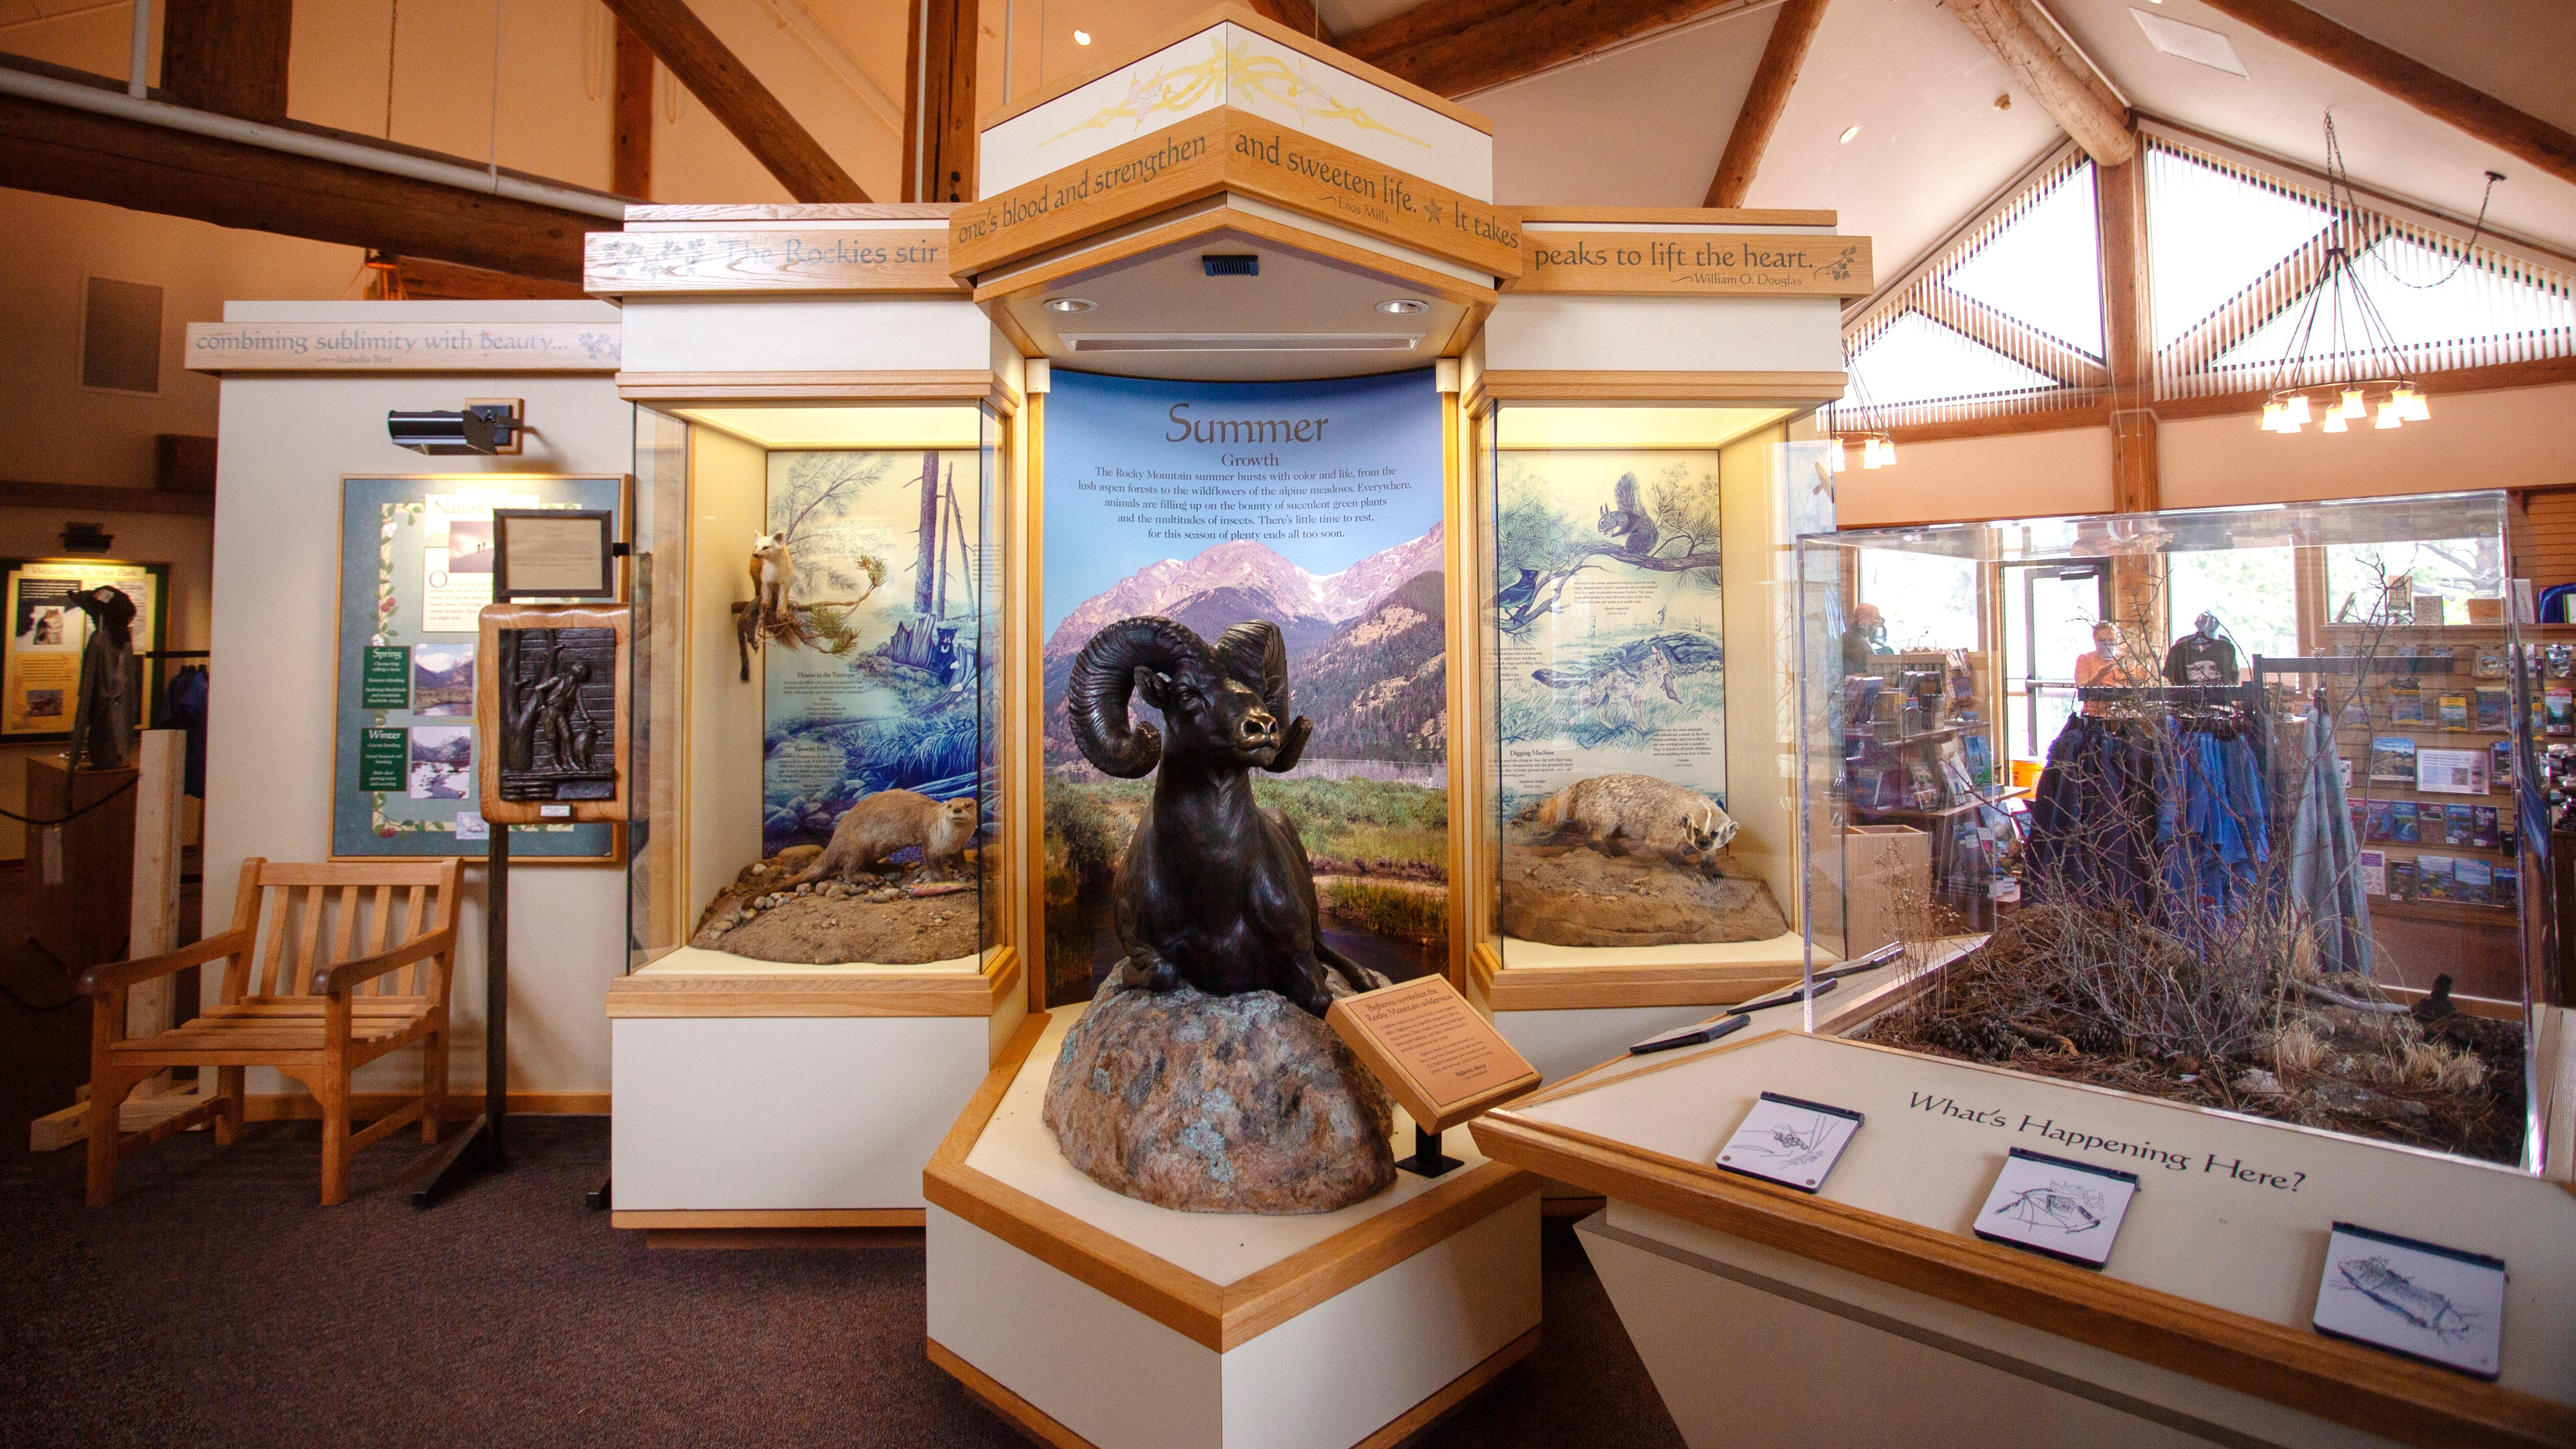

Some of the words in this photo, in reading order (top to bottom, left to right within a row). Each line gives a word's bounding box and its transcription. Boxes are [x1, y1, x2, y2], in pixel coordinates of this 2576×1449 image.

[1235, 133, 1281, 168] and
[1286, 148, 1376, 198] sweeten
[1383, 173, 1417, 214] life.
[957, 208, 998, 244] one's
[1002, 185, 1050, 231] blood
[1053, 169, 1090, 208] and
[1094, 131, 1206, 194] strengthen
[1336, 195, 1362, 213] Enos
[1363, 202, 1390, 224] Mills
[1454, 201, 1470, 231] It
[1474, 212, 1519, 249] takes
[719, 240, 775, 265] The
[784, 238, 887, 265] Rockies
[895, 238, 939, 264] stir
[1534, 241, 1607, 270] peaks
[1618, 245, 1641, 266] to
[1651, 241, 1686, 272] lift
[1696, 243, 1736, 268] the
[1742, 243, 1814, 269] heart.
[1694, 273, 1736, 285] William
[1740, 274, 1754, 285] O.
[1757, 274, 1802, 288] Douglas
[196, 330, 308, 354] combining
[316, 330, 417, 354] sublimity
[424, 330, 472, 350] with
[481, 330, 569, 354] beauty...
[1166, 403, 1328, 443] Summer
[1221, 453, 1279, 467] Growth
[1095, 467, 1113, 477] The
[1117, 468, 1144, 480] Rocky
[1147, 470, 1192, 480] Mountain
[1238, 471, 1266, 481] bursts
[1270, 471, 1290, 480] with
[1294, 470, 1317, 480] color
[1320, 470, 1335, 479] and
[1339, 469, 1355, 479] life,
[1358, 468, 1379, 477] from
[1383, 466, 1396, 475] the
[1078, 481, 1096, 490] lush
[1099, 485, 1125, 493] aspen
[1128, 484, 1157, 493] forests
[1174, 485, 1188, 494] the
[1192, 486, 1246, 495] wildflowers
[1249, 486, 1258, 495] of
[1261, 486, 1276, 495] the
[1279, 485, 1307, 496] alpine
[1310, 484, 1354, 494] meadows.
[433, 500, 487, 515] Natural
[1105, 498, 1140, 508] animals
[1160, 499, 1187, 510] filling
[1220, 501, 1235, 510] the
[1239, 501, 1271, 512] bounty
[1275, 501, 1284, 510] of
[1287, 500, 1331, 509] succulent
[1333, 501, 1358, 510] green
[1360, 498, 1387, 509] plants
[1118, 514, 1134, 522] and
[1138, 514, 1152, 522] the
[1155, 515, 1205, 524] multitudes
[1208, 515, 1218, 524] of
[1220, 516, 1255, 524] insects.
[1258, 515, 1293, 524] There's
[1296, 515, 1316, 523] little
[1320, 515, 1340, 523] time
[1148, 529, 1161, 538] for
[1165, 530, 1181, 538] this
[1219, 530, 1229, 539] of
[1231, 530, 1260, 541] plenty
[1264, 530, 1285, 539] ends
[1289, 530, 1299, 539] all
[1365, 1000, 1396, 1012] Bighorns
[1398, 991, 1427, 1004] symbolize
[1427, 989, 1438, 997] the
[1365, 1012, 1388, 1022] Rocky
[1389, 1003, 1422, 1015] Mountain
[1422, 994, 1453, 1007] wilderness
[1910, 1091, 2009, 1130] What's
[2018, 1115, 2189, 1172] Happening
[2205, 1154, 2307, 1194] Here?
